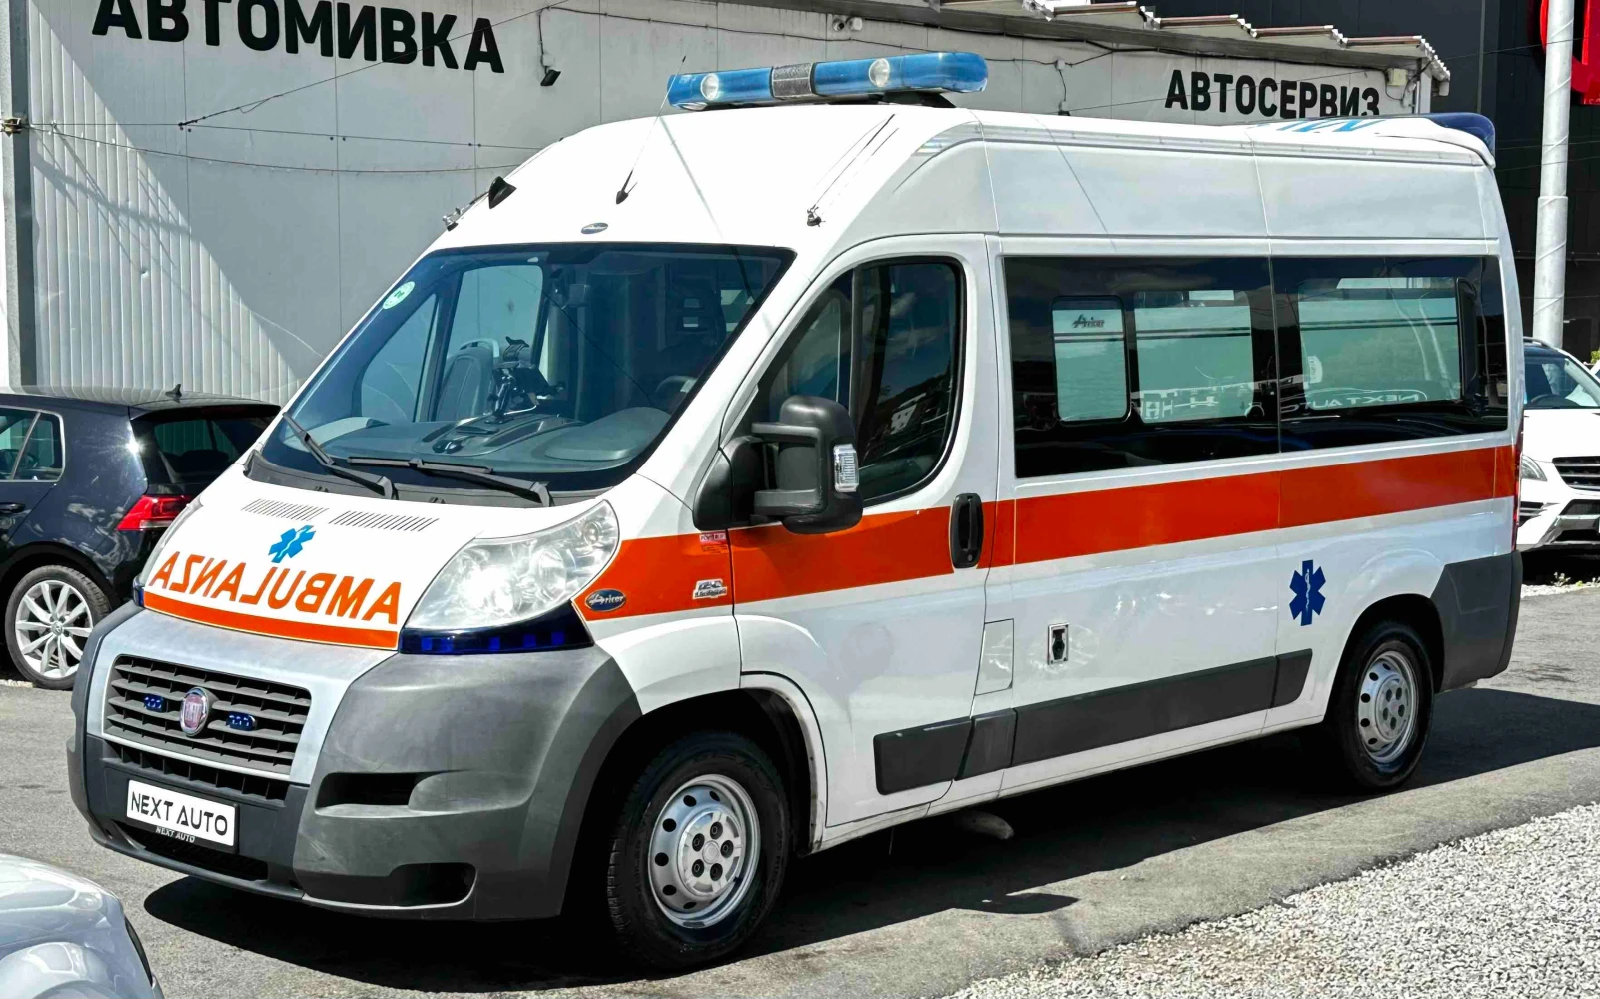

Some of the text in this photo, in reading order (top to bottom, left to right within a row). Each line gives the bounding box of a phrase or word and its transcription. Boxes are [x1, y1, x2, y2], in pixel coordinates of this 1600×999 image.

[92, 0, 505, 73] АВТОМИВКА
[1164, 69, 1380, 119] АВТОСЕРВИЗ
[131, 791, 228, 836] NEXT AUTO
[155, 825, 196, 844] NEXT AUTO
